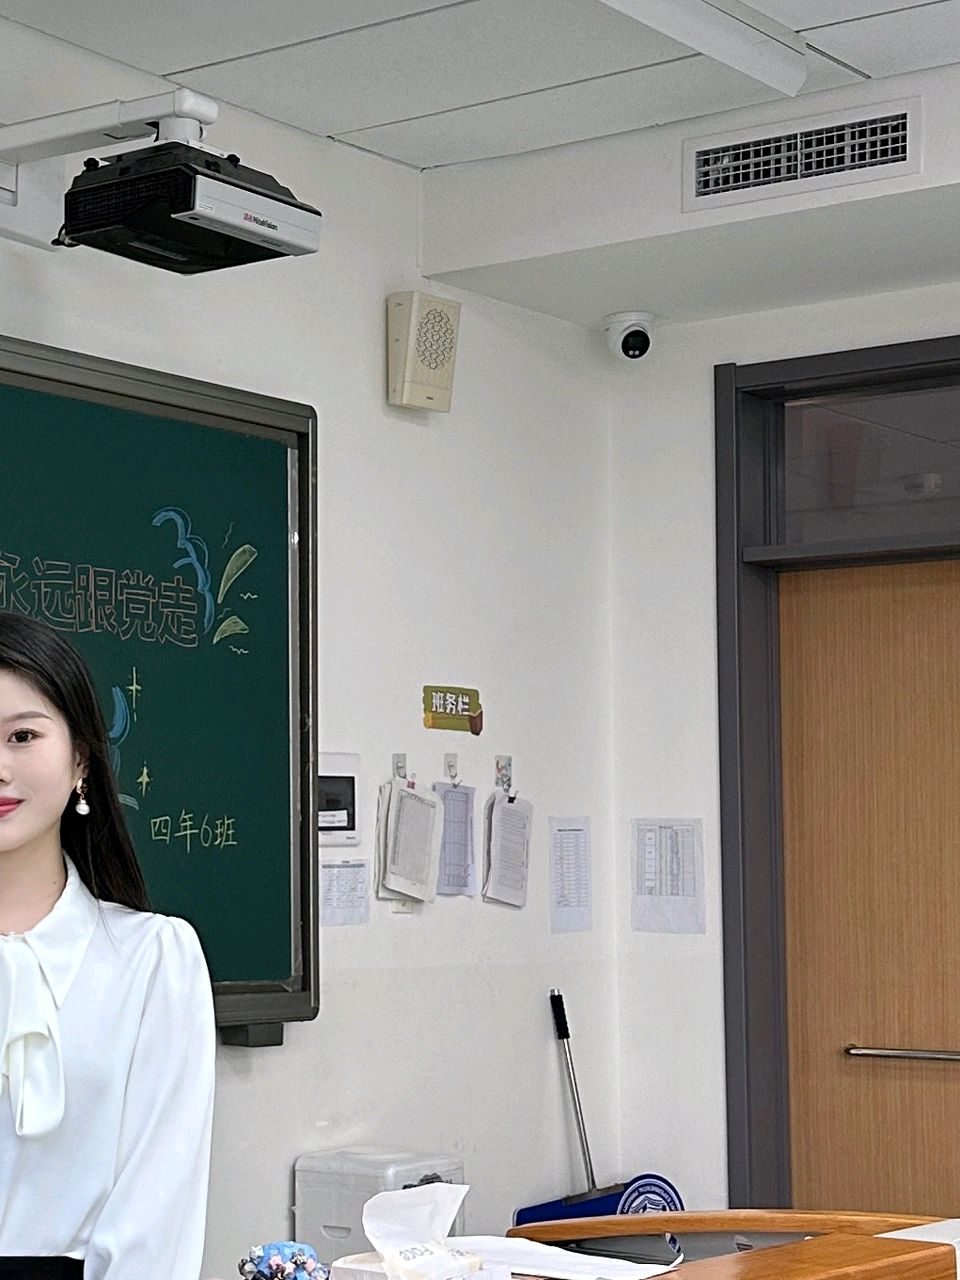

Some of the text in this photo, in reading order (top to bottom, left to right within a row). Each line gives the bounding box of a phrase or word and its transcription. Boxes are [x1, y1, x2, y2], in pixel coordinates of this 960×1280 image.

[431, 691, 470, 716] 班务栏
[150, 808, 238, 854] 四年6班
